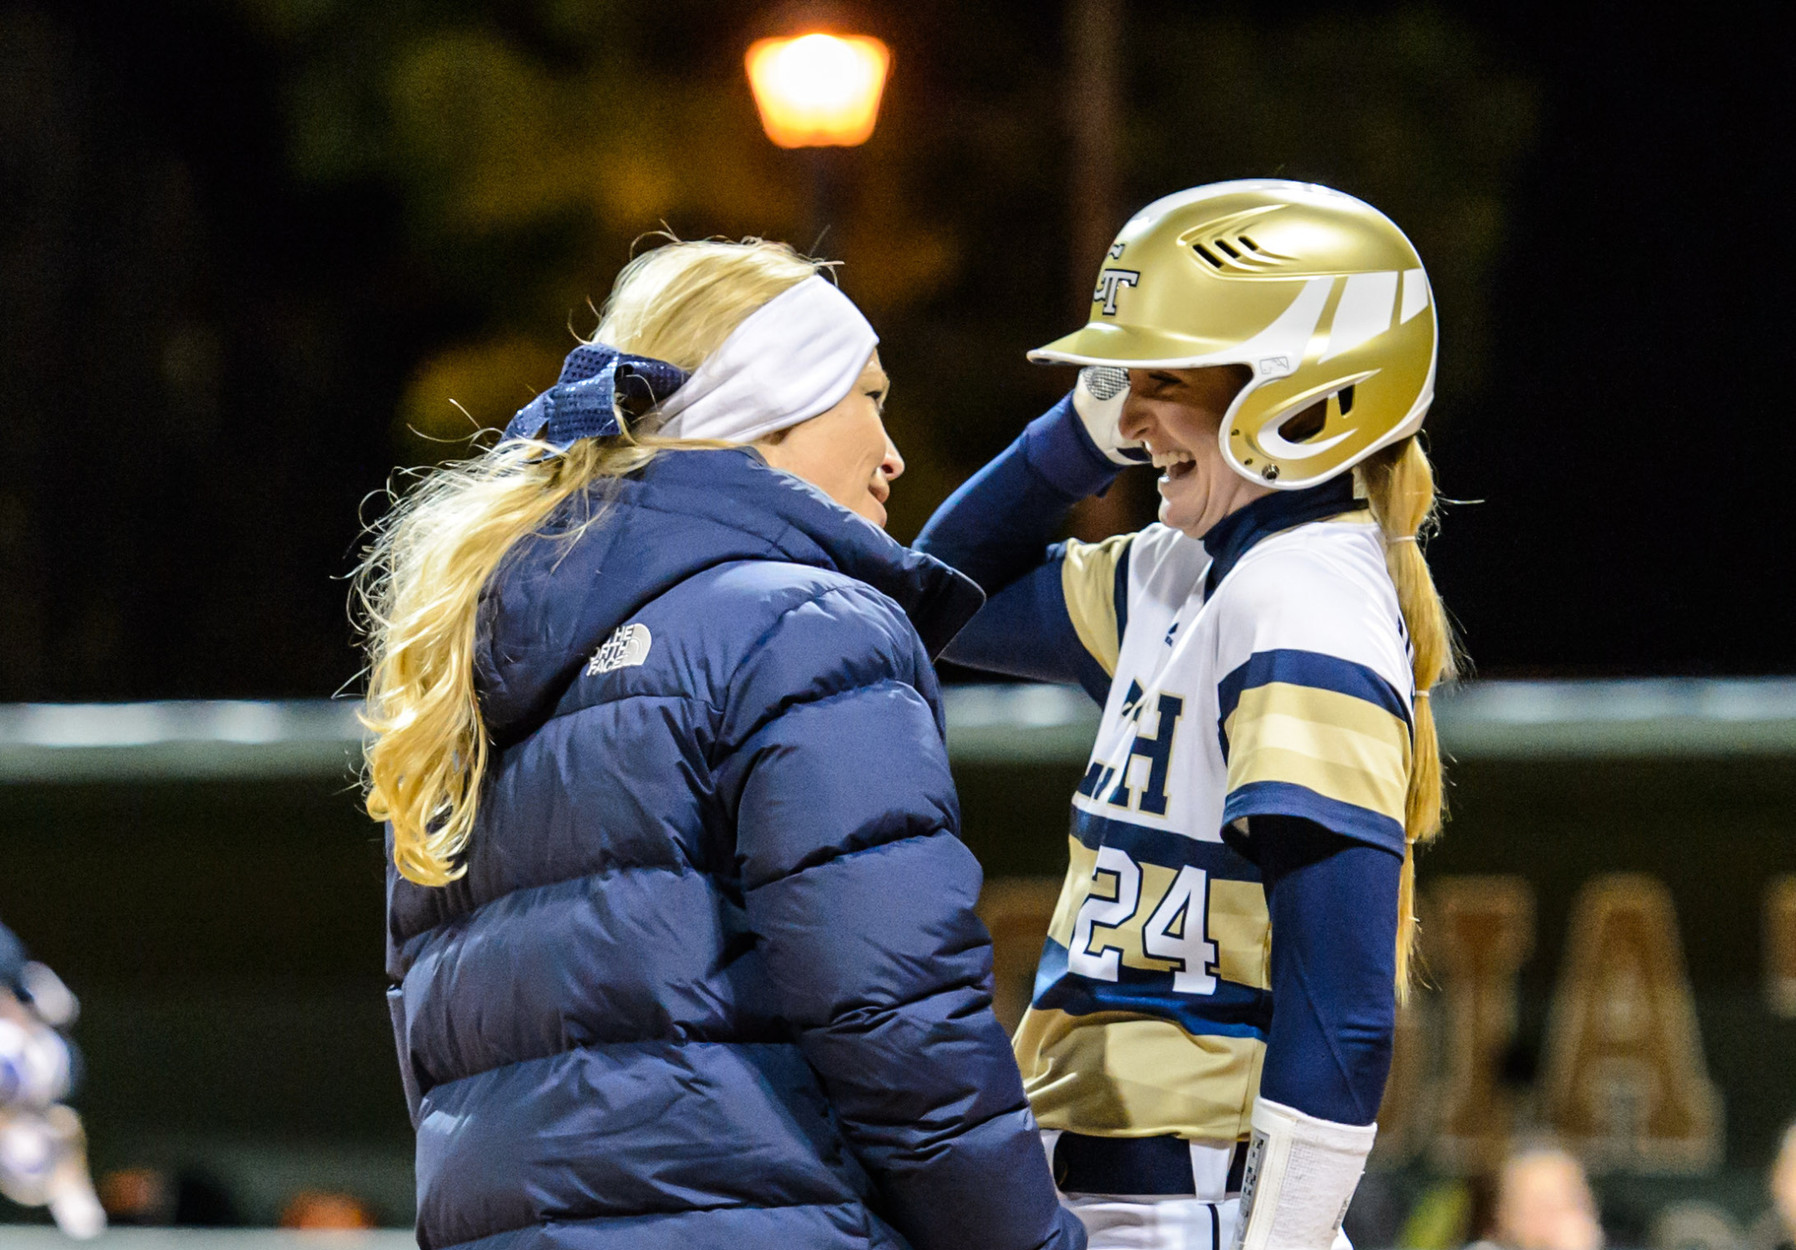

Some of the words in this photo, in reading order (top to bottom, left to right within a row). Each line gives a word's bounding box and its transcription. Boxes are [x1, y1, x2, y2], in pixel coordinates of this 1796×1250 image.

[606, 624, 634, 645] HE
[586, 655, 625, 677] FACE
[1067, 843, 1220, 996] 24
